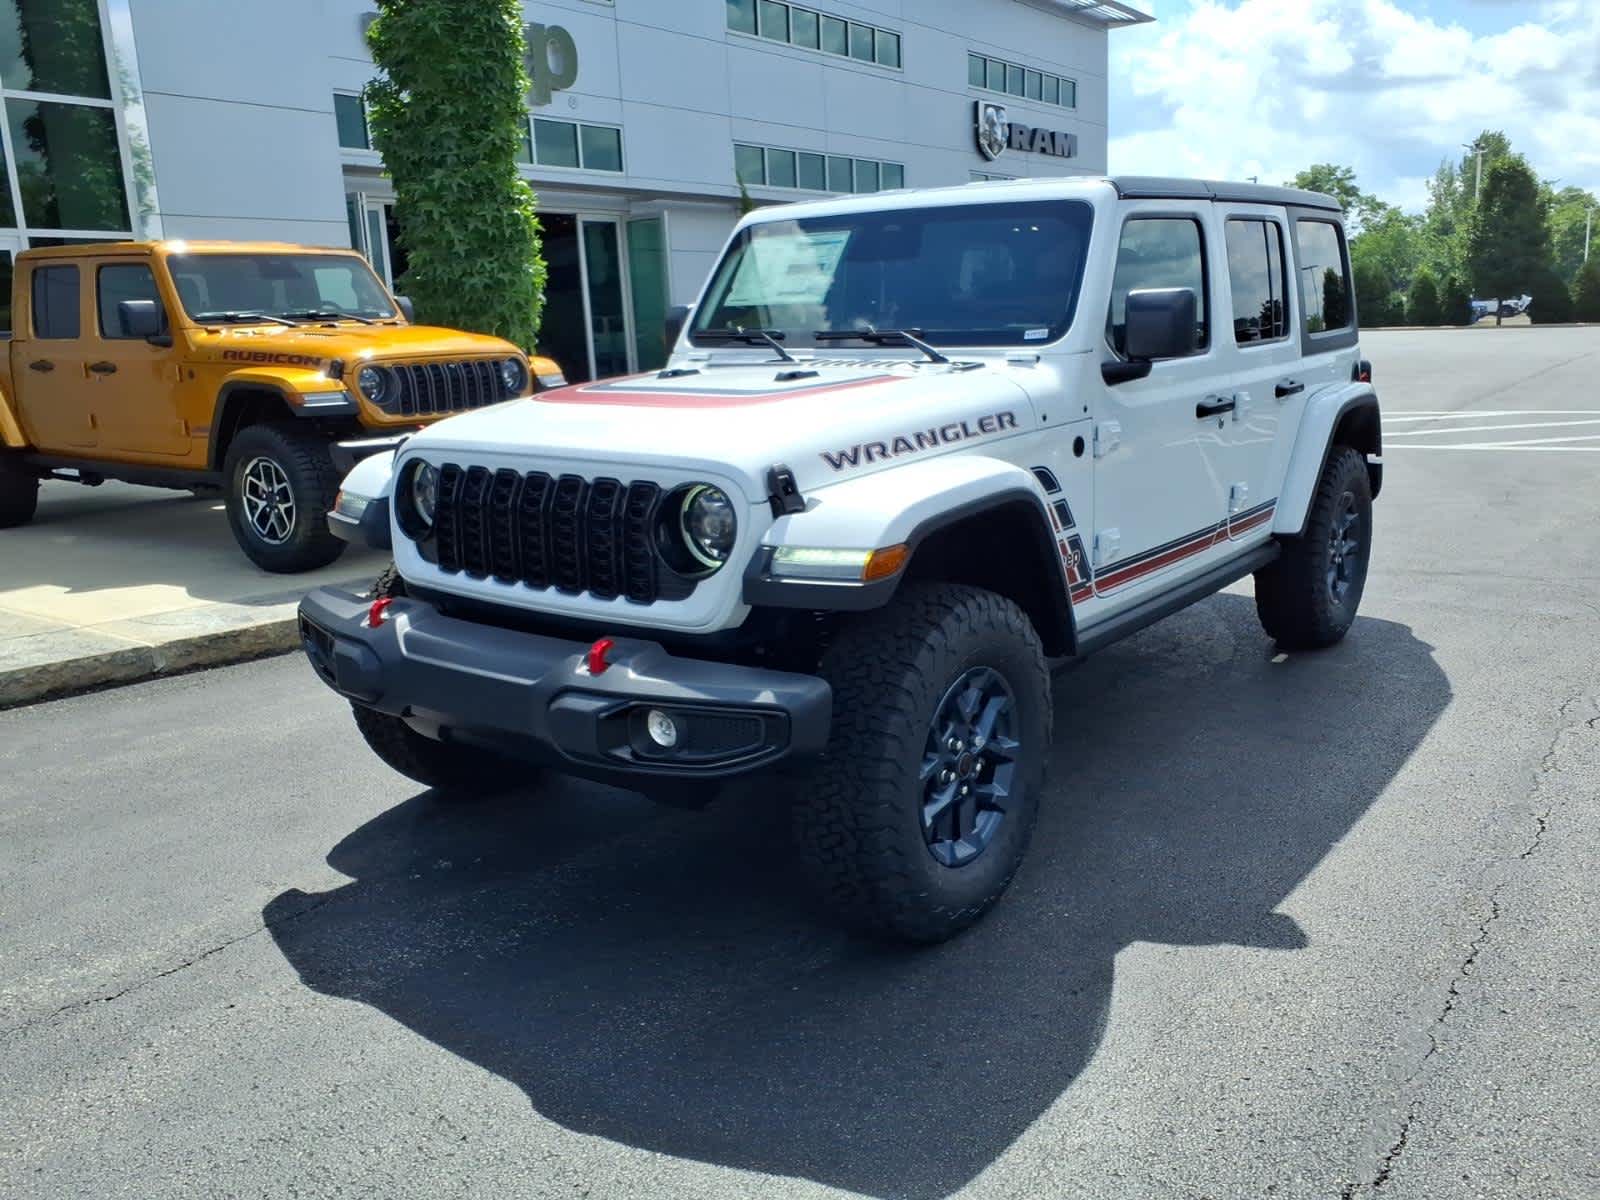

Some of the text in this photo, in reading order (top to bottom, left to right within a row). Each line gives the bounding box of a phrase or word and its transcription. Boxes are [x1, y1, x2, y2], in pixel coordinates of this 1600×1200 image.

[1008, 123, 1077, 157] RAM
[223, 350, 321, 366] RUBICON
[821, 411, 1018, 471] WRANGLER
